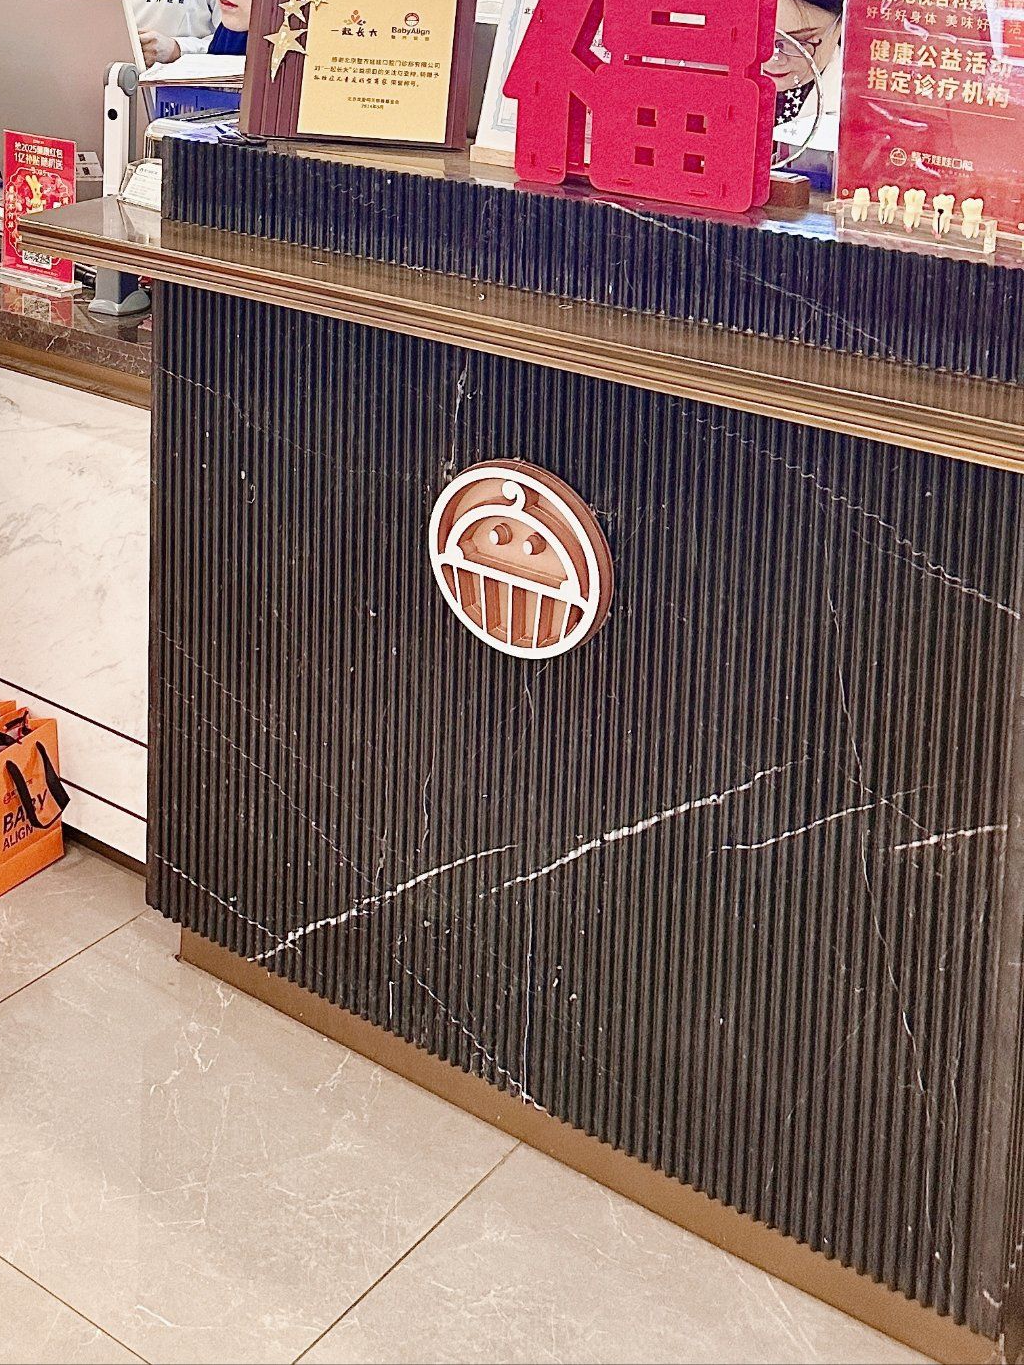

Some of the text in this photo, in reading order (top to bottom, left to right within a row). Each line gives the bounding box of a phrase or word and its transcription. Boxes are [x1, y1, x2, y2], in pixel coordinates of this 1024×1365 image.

[391, 26, 431, 36] BabyAlign
[867, 67, 1011, 110] 指定诊疗机构
[3, 788, 48, 835] BAY
